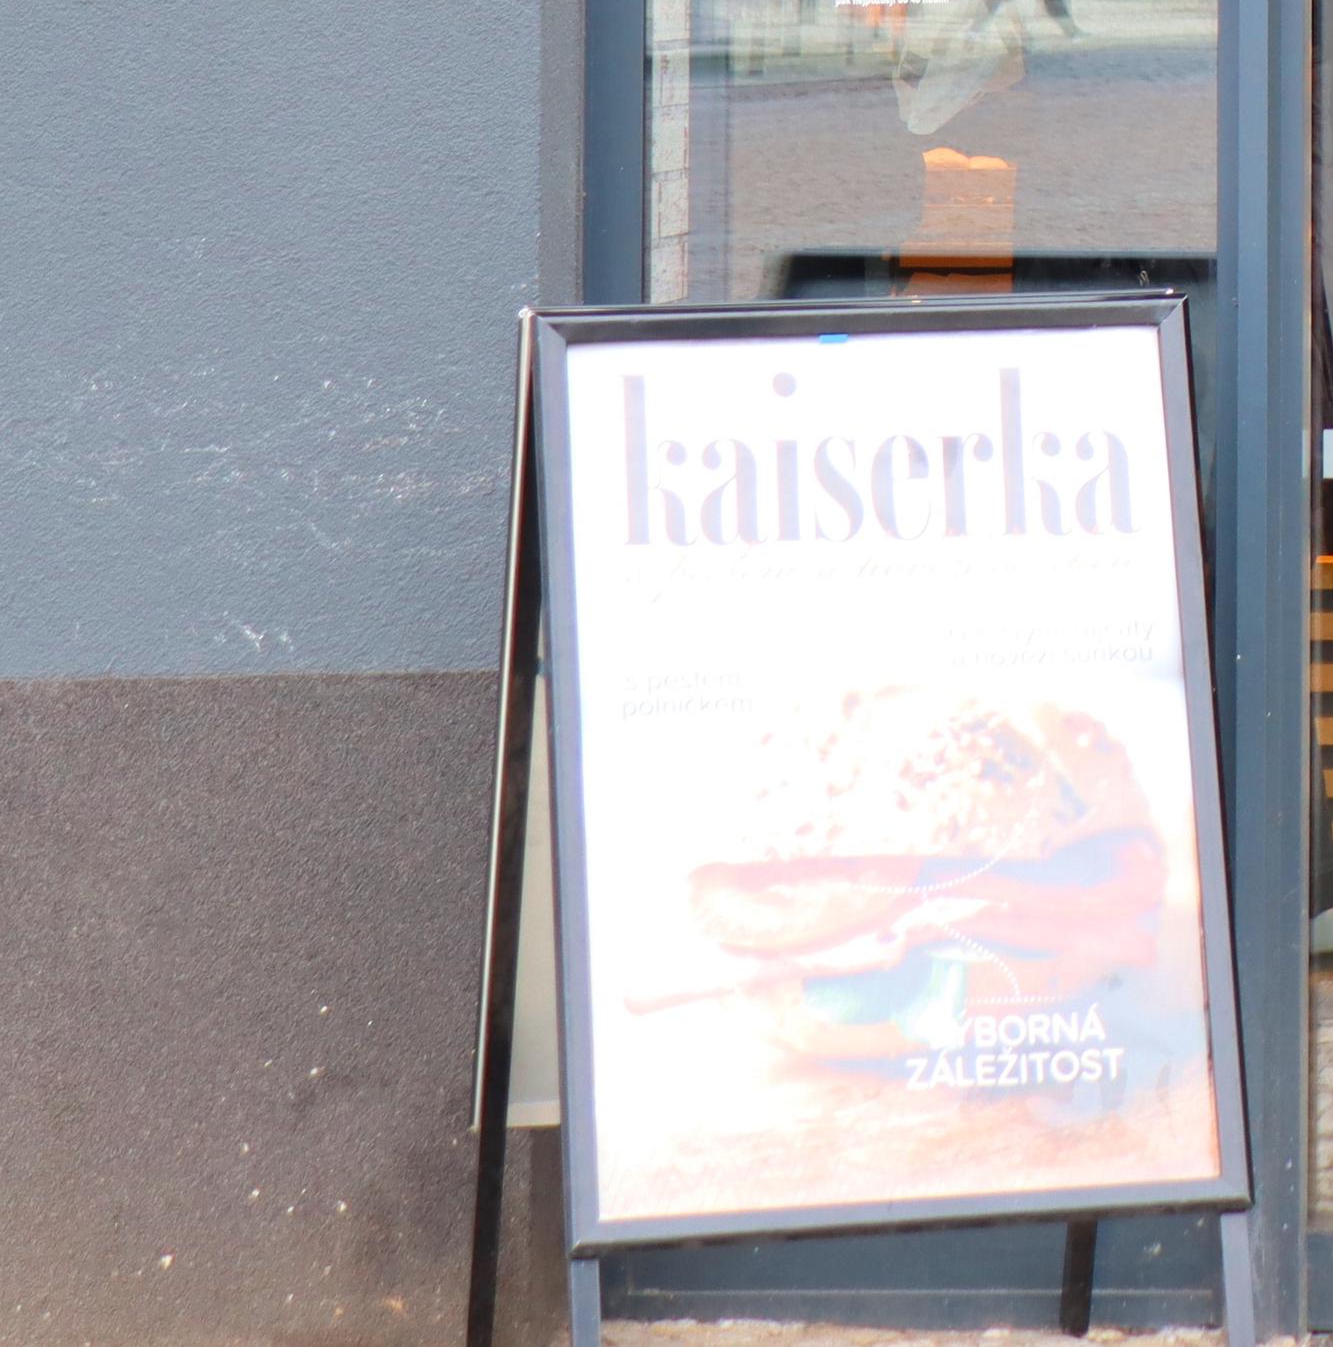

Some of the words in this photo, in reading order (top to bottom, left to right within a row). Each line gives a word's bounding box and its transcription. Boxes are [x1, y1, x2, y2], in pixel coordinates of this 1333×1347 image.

[620, 369, 1142, 548] kaiserka
[932, 1002, 1107, 1049] ÝBORNÁ
[905, 1047, 1125, 1091] ZÁLEŽITOST
